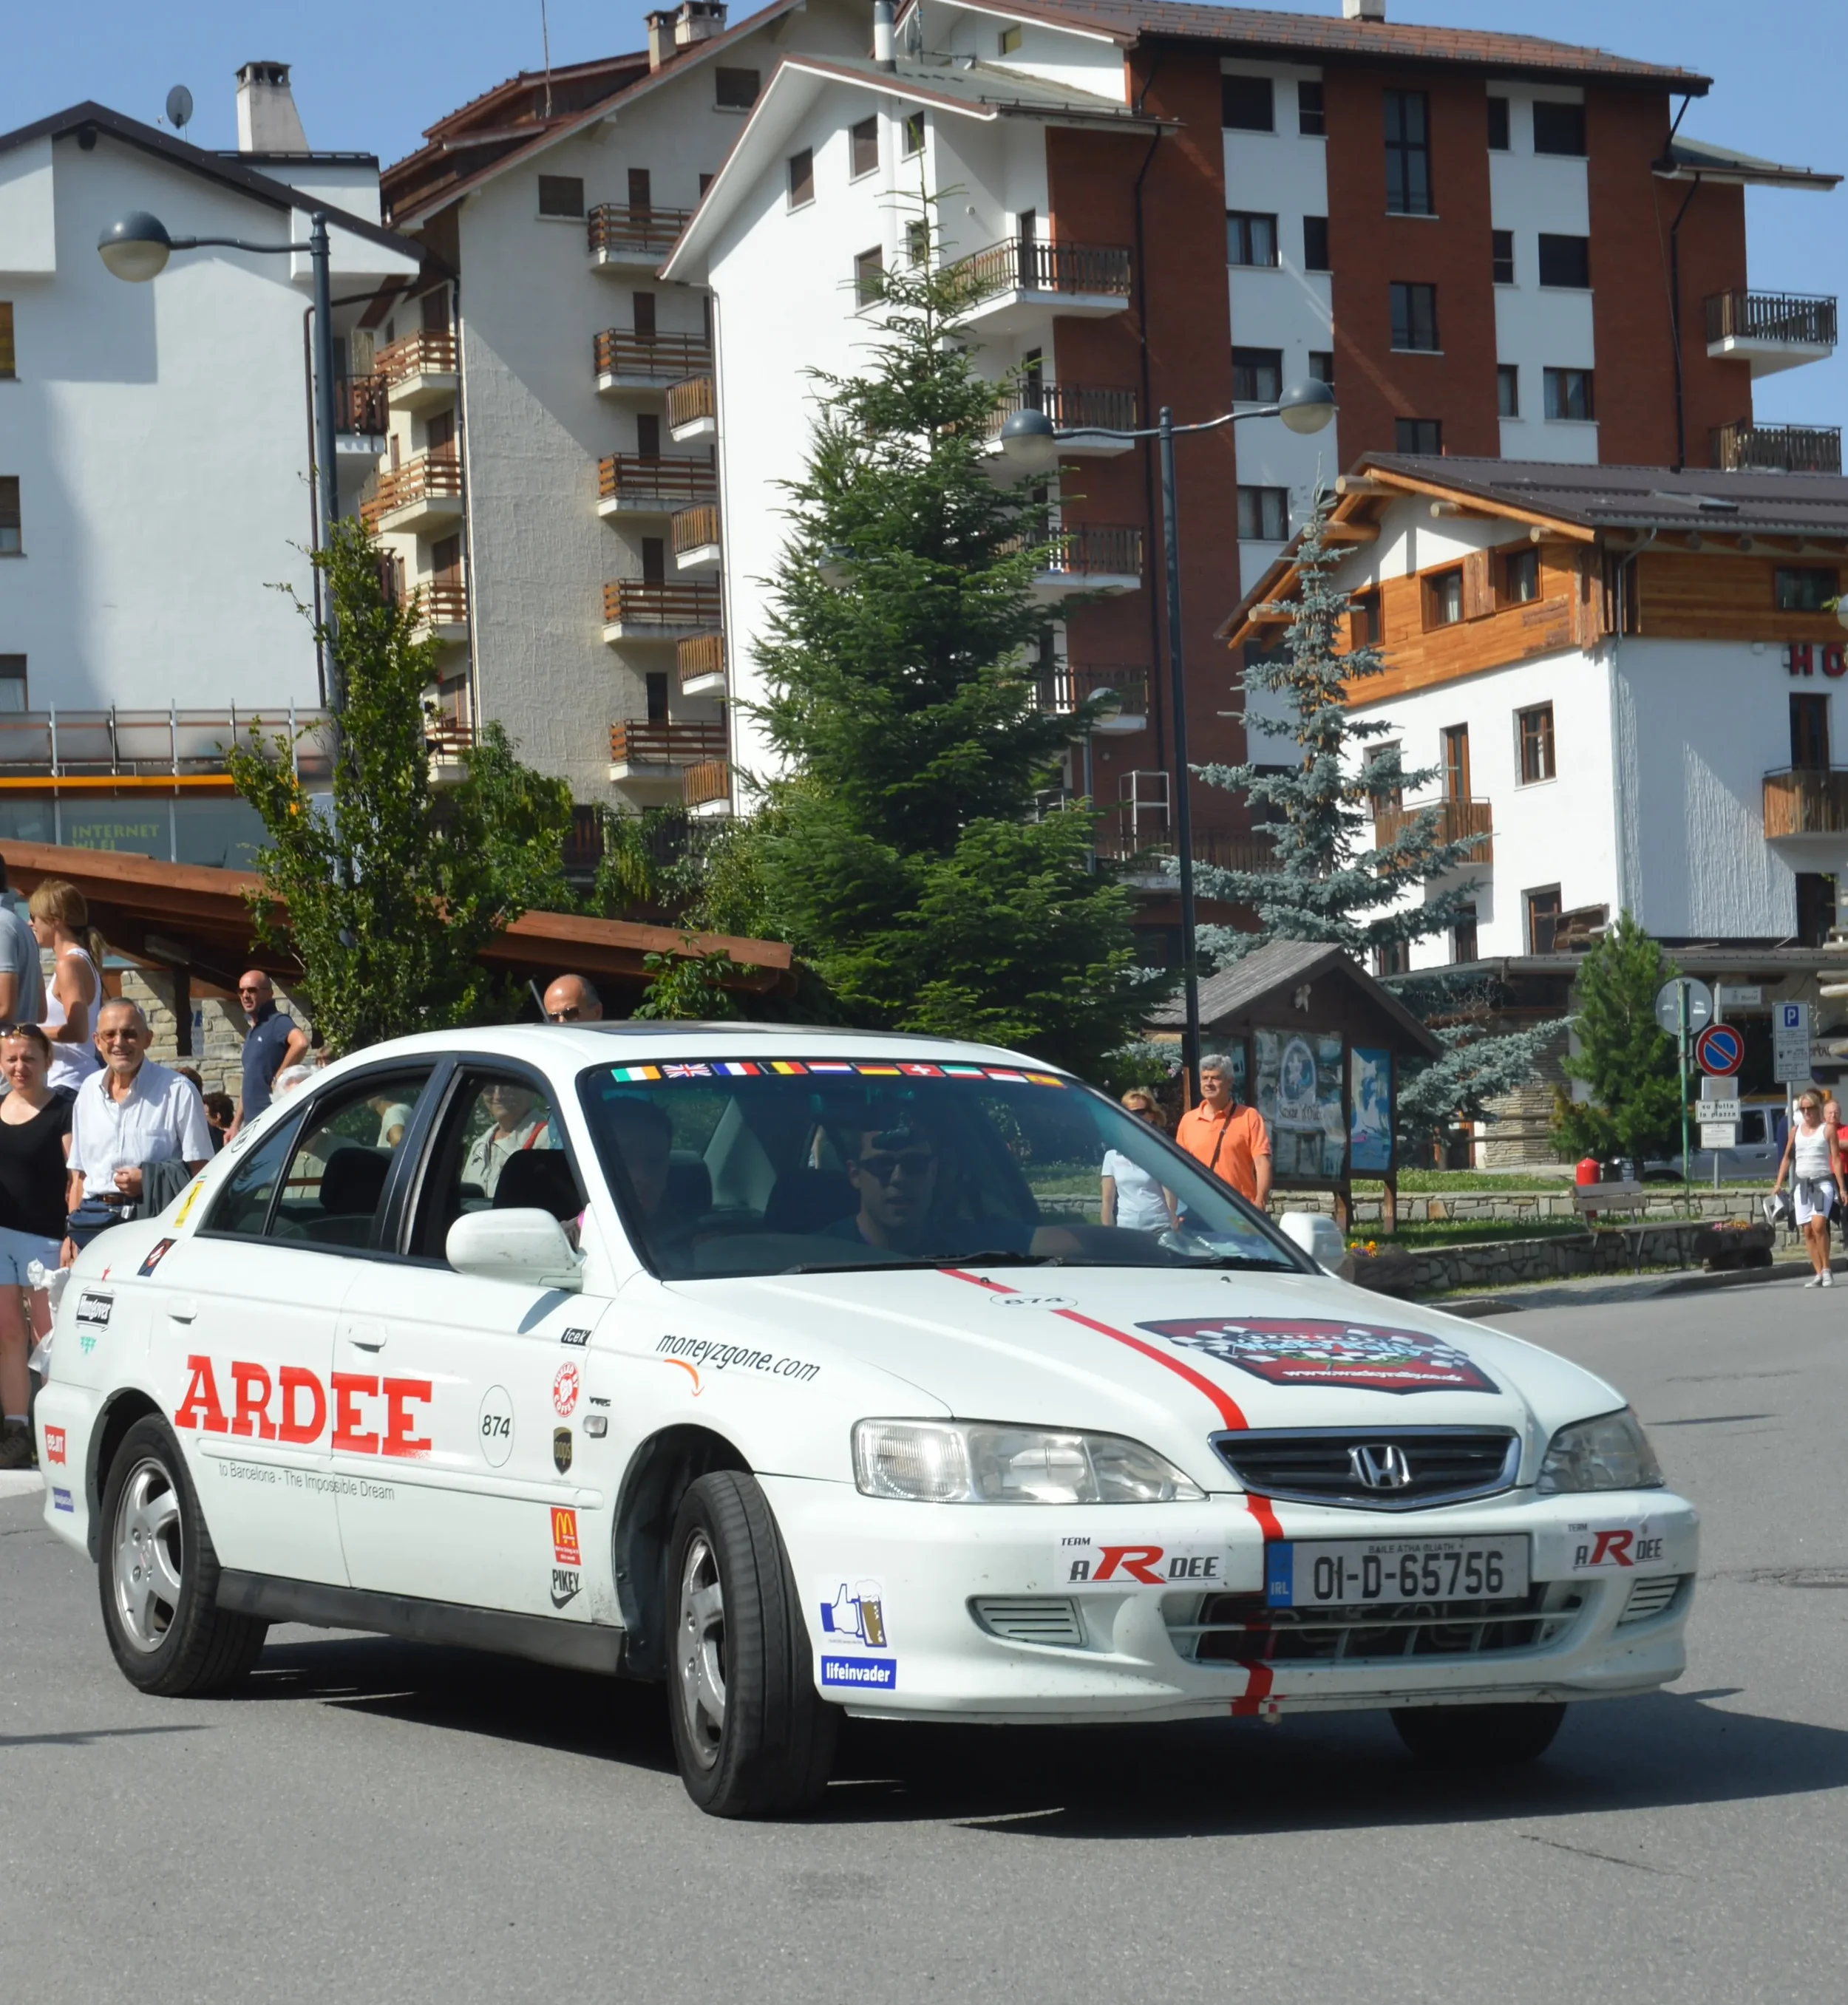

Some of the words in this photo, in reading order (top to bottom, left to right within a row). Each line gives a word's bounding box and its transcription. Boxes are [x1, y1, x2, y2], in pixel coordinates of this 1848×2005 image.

[72, 824, 160, 839] INTERNET
[78, 1295, 110, 1320] Hungover
[655, 1334, 821, 1382] moneyzgone.com
[174, 1354, 432, 1460] ARDEE
[482, 1414, 511, 1439] 874
[219, 1462, 228, 1477] to
[230, 1463, 276, 1483] Barcelona
[284, 1469, 302, 1487] The
[305, 1473, 358, 1496] Impossible
[360, 1480, 395, 1500] Dream
[1061, 1537, 1091, 1546] TEAM
[552, 1569, 580, 1593] PIKEY
[1270, 1581, 1289, 1595] IRL
[1314, 1550, 1504, 1601] 01-D-65756
[826, 1662, 891, 1683] lifeinvader
